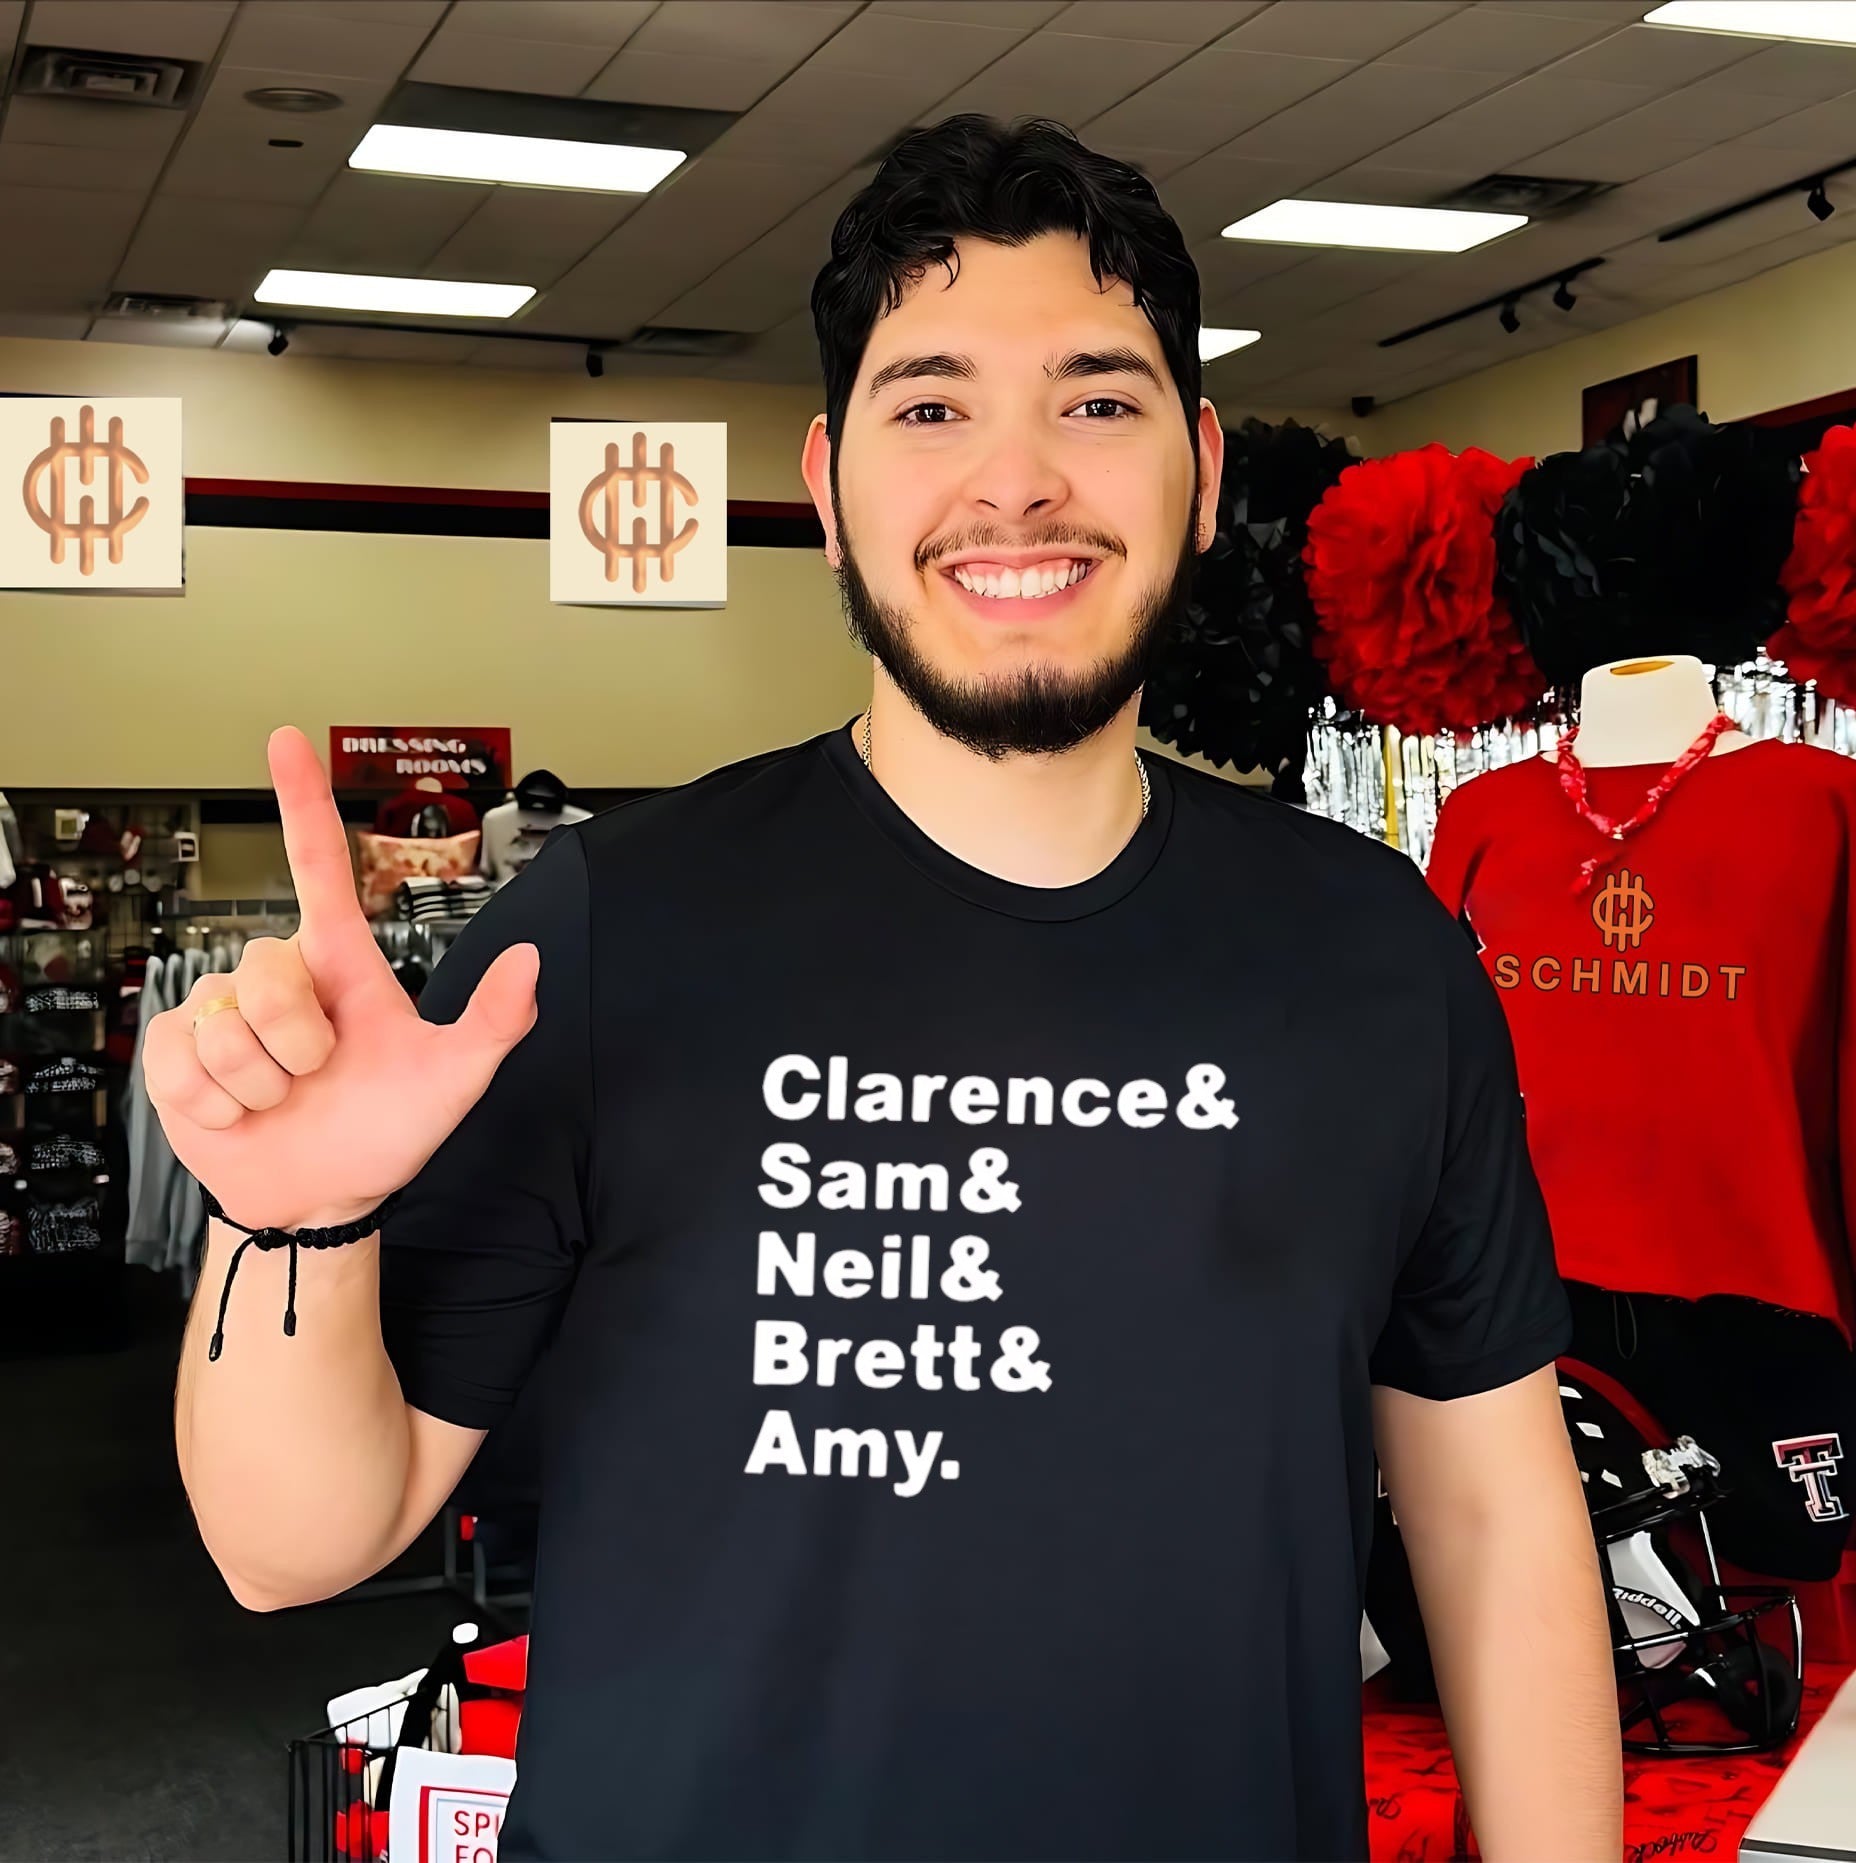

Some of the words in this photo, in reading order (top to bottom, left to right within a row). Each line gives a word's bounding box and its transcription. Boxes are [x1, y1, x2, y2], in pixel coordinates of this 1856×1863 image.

[342, 737, 467, 754] DRESSING
[396, 758, 487, 774] ROOMS
[1494, 952, 1746, 1000] SCHMIDT
[763, 1054, 1239, 1129] Clarence&
[758, 1143, 1022, 1213] Sam&
[757, 1231, 1003, 1302] Neil&
[753, 1320, 1052, 1392] Brett&
[744, 1410, 959, 1497] Amy.
